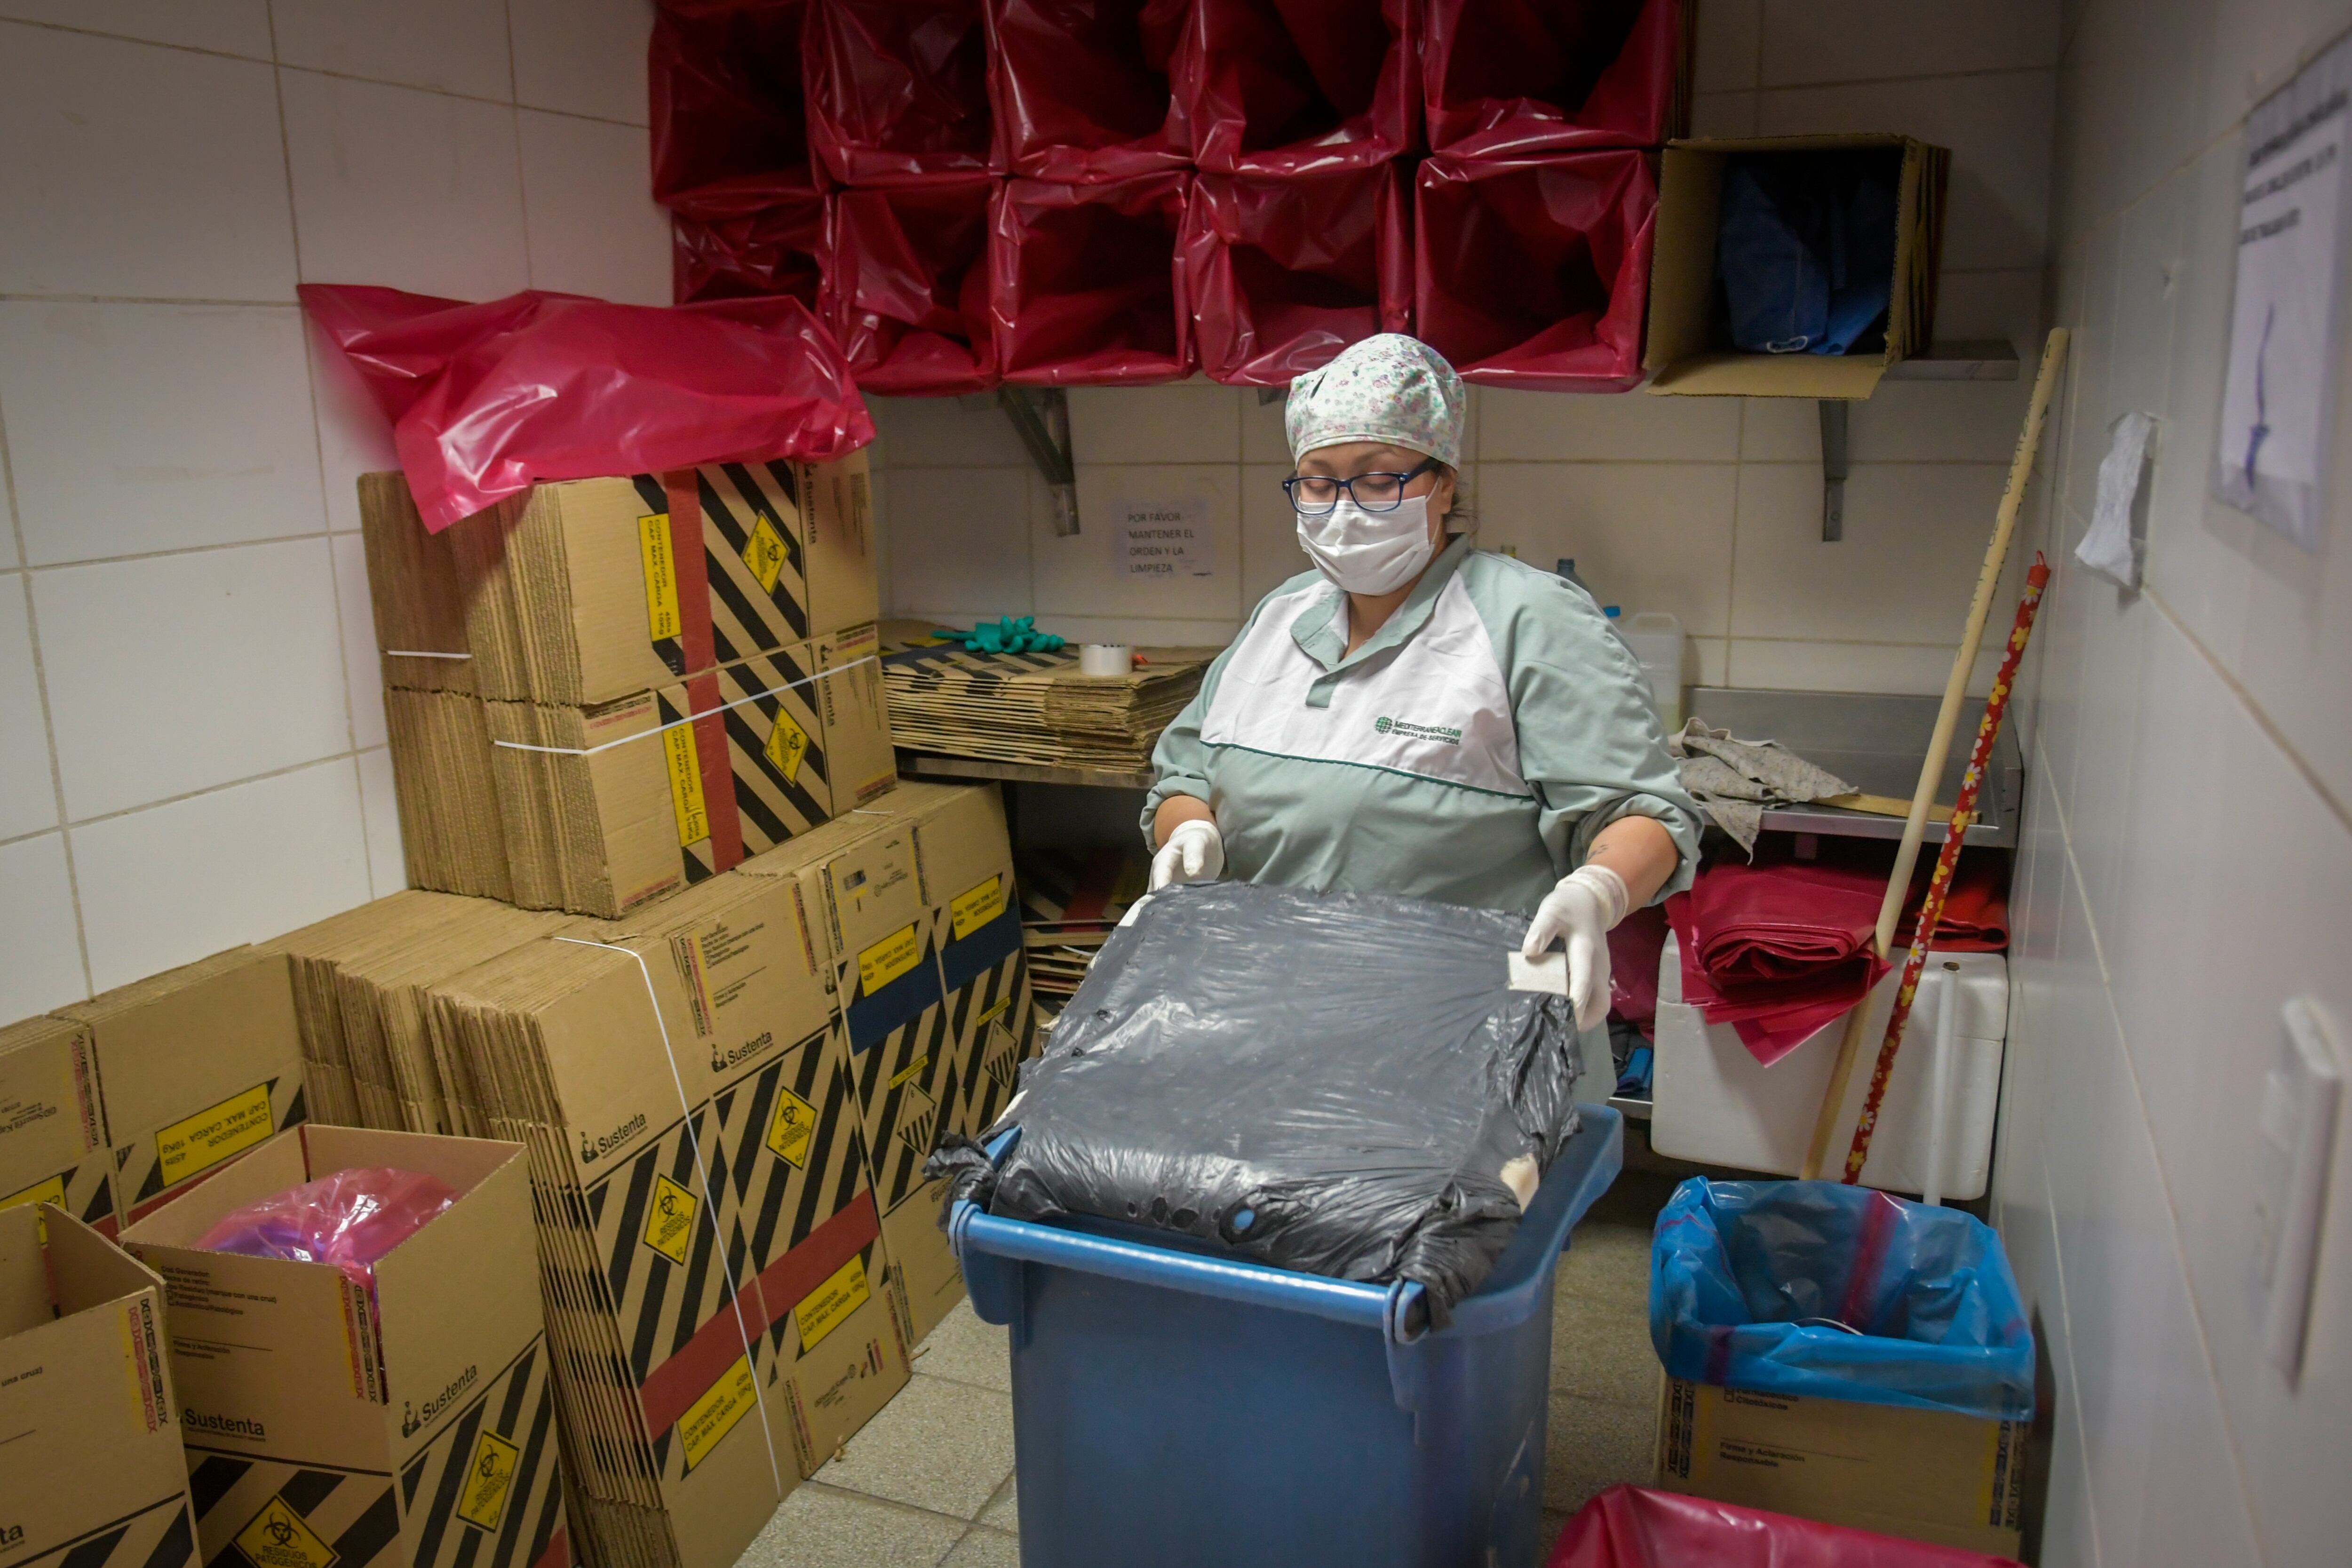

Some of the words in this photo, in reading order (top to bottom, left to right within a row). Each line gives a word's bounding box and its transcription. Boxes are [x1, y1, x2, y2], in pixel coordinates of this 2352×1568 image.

[1128, 514, 1146, 522] POR
[1149, 513, 1181, 521] FAVOR
[1129, 530, 1181, 539] MANTENER
[1184, 529, 1194, 538] EL
[655, 519, 667, 587] CONTENEDOR
[1129, 547, 1161, 556] ORDEN
[1173, 547, 1184, 556] LA
[1130, 564, 1173, 573] LIMPIEZA
[654, 572, 662, 607] CARGA
[1429, 735, 1460, 745] SERVICIOS
[680, 728, 693, 793] CONTENEDOR
[728, 1032, 772, 1064] Sustenta
[189, 1122, 222, 1142] CARGA
[207, 1113, 268, 1147] CONTENEDOR
[598, 1113, 646, 1153] Sustenta
[1, 1375, 18, 1387] una
[20, 1367, 42, 1380] cruz)
[422, 1365, 477, 1421] Sustenta
[684, 1395, 725, 1440] CONTENEDOR
[716, 1397, 737, 1421] CARGA
[185, 1409, 264, 1436] Sustenta
[255, 1553, 316, 1568] PATOGENICOS
[262, 1545, 307, 1560] RESIDUOS
